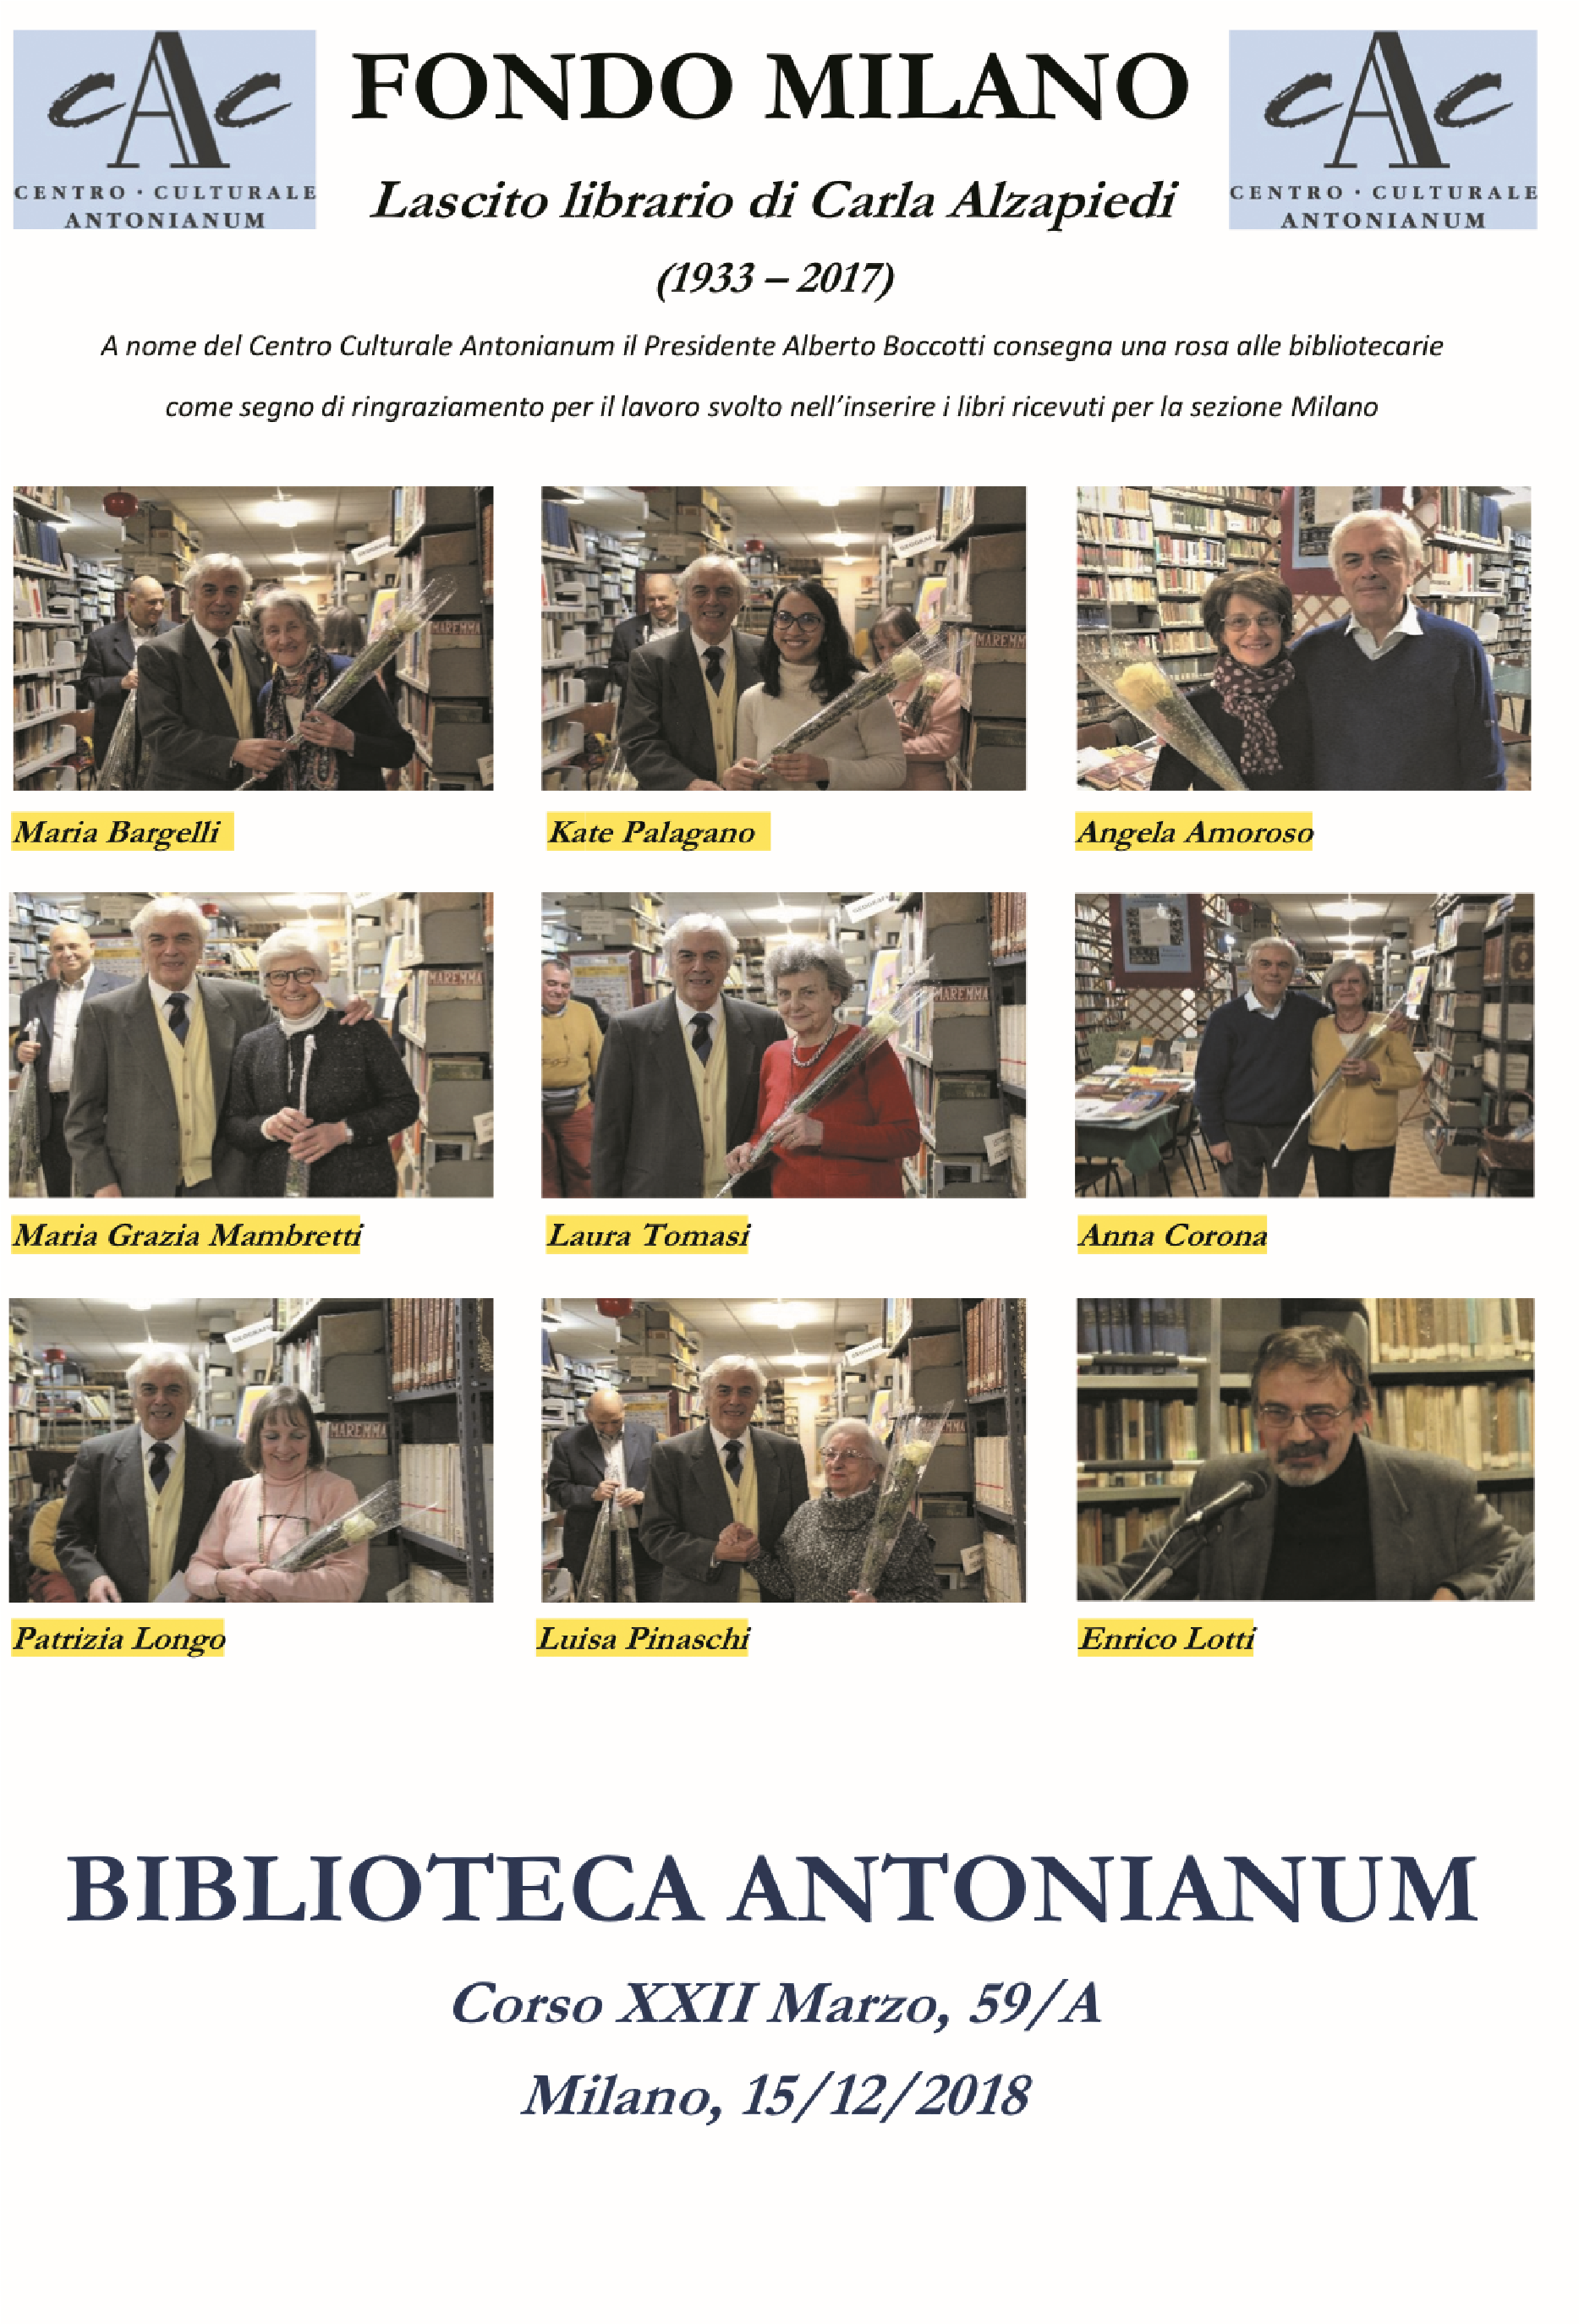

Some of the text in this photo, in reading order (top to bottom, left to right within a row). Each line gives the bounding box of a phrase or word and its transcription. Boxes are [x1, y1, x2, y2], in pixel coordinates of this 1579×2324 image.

[351, 52, 1189, 121] FONDO MILANO
[14, 185, 125, 200] CENTRO
[154, 185, 316, 200] CULTURALE
[369, 180, 1180, 232] Lascito librario di Carla Alzapiedi
[1230, 185, 1343, 200] CENTRO
[1373, 185, 1537, 200] CULTURALE
[64, 212, 264, 229] ANTONIANUM
[1280, 212, 1485, 229] ANTONIANUM
[657, 261, 756, 304] (1933
[795, 261, 894, 304] 2017)
[100, 333, 1444, 362] A nome del Centro Culturale Antonianum il Presidente Alberto Boccotti consegna una rosa alle bibliotecarie
[166, 401, 233, 417] come
[238, 401, 314, 423] segno
[321, 394, 345, 417] di
[351, 395, 544, 423] ringraziamento
[550, 401, 594, 423] per
[600, 394, 616, 417] il
[621, 394, 699, 417] lavoro
[707, 394, 781, 417] svolto
[942, 395, 951, 417] i
[957, 394, 1005, 417] libri
[1012, 395, 1105, 417] ricevuti
[1110, 401, 1154, 423] per
[1160, 394, 1182, 417] la
[1190, 395, 1282, 417] sezione
[1291, 394, 1379, 417] Milano
[12, 820, 222, 852] Maria Bargelli
[546, 820, 756, 852] Kate Palagano
[1074, 820, 1315, 852] Angela Amoroso
[425, 972, 483, 985] MAREMMA
[12, 1223, 365, 1247] Maria Grazia Mambretti
[546, 1222, 752, 1247] Laura Tomasi
[1077, 1223, 1268, 1247] Anna Corona
[330, 1422, 387, 1439] MAREMMA
[12, 1626, 227, 1658] Patrizia Longo
[535, 1626, 752, 1650] Luisa Pinaschi
[1077, 1626, 1258, 1650] Enrico Lotti
[67, 1852, 1478, 1923] BIBLIOTECA ANTONIANUM
[452, 1978, 1101, 2034] Corso XXII Marzo, 59/A
[519, 2070, 1032, 2126] Milano, 15/12/2018
